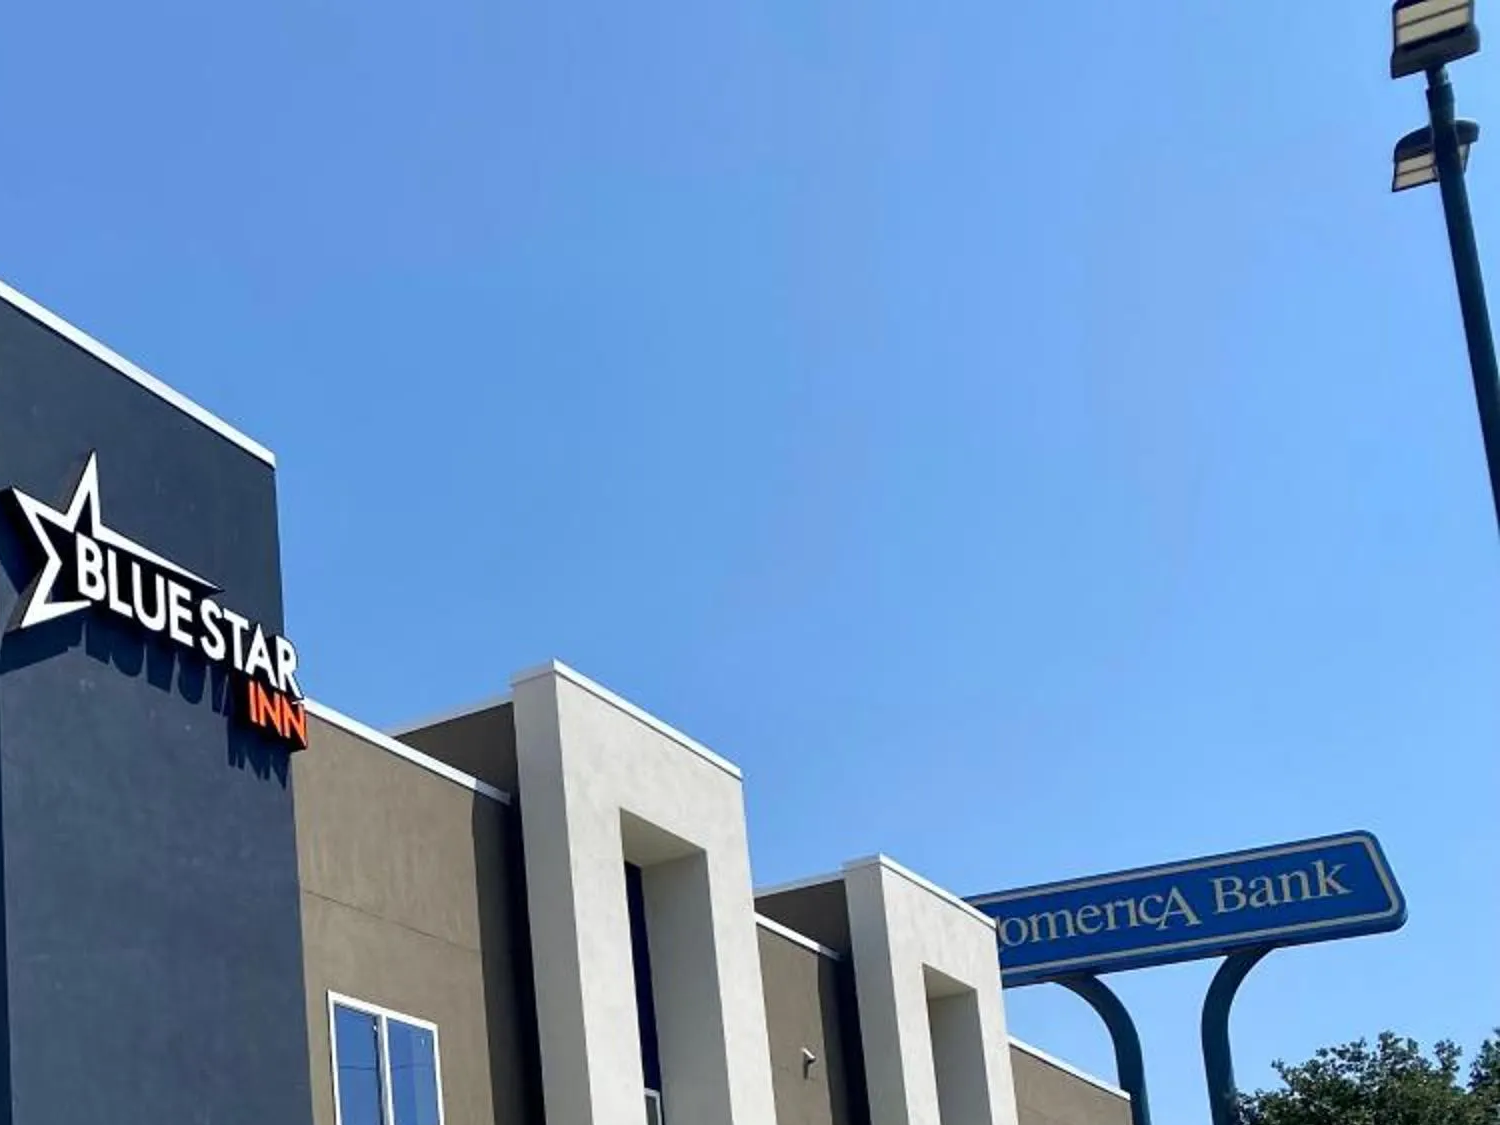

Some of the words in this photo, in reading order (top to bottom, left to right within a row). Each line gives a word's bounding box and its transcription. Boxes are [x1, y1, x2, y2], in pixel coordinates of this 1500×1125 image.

[76, 531, 194, 647] BLUE
[200, 598, 304, 699] STAR
[249, 679, 308, 748] INN
[996, 885, 1202, 950] omericA
[1208, 859, 1353, 915] Bank
